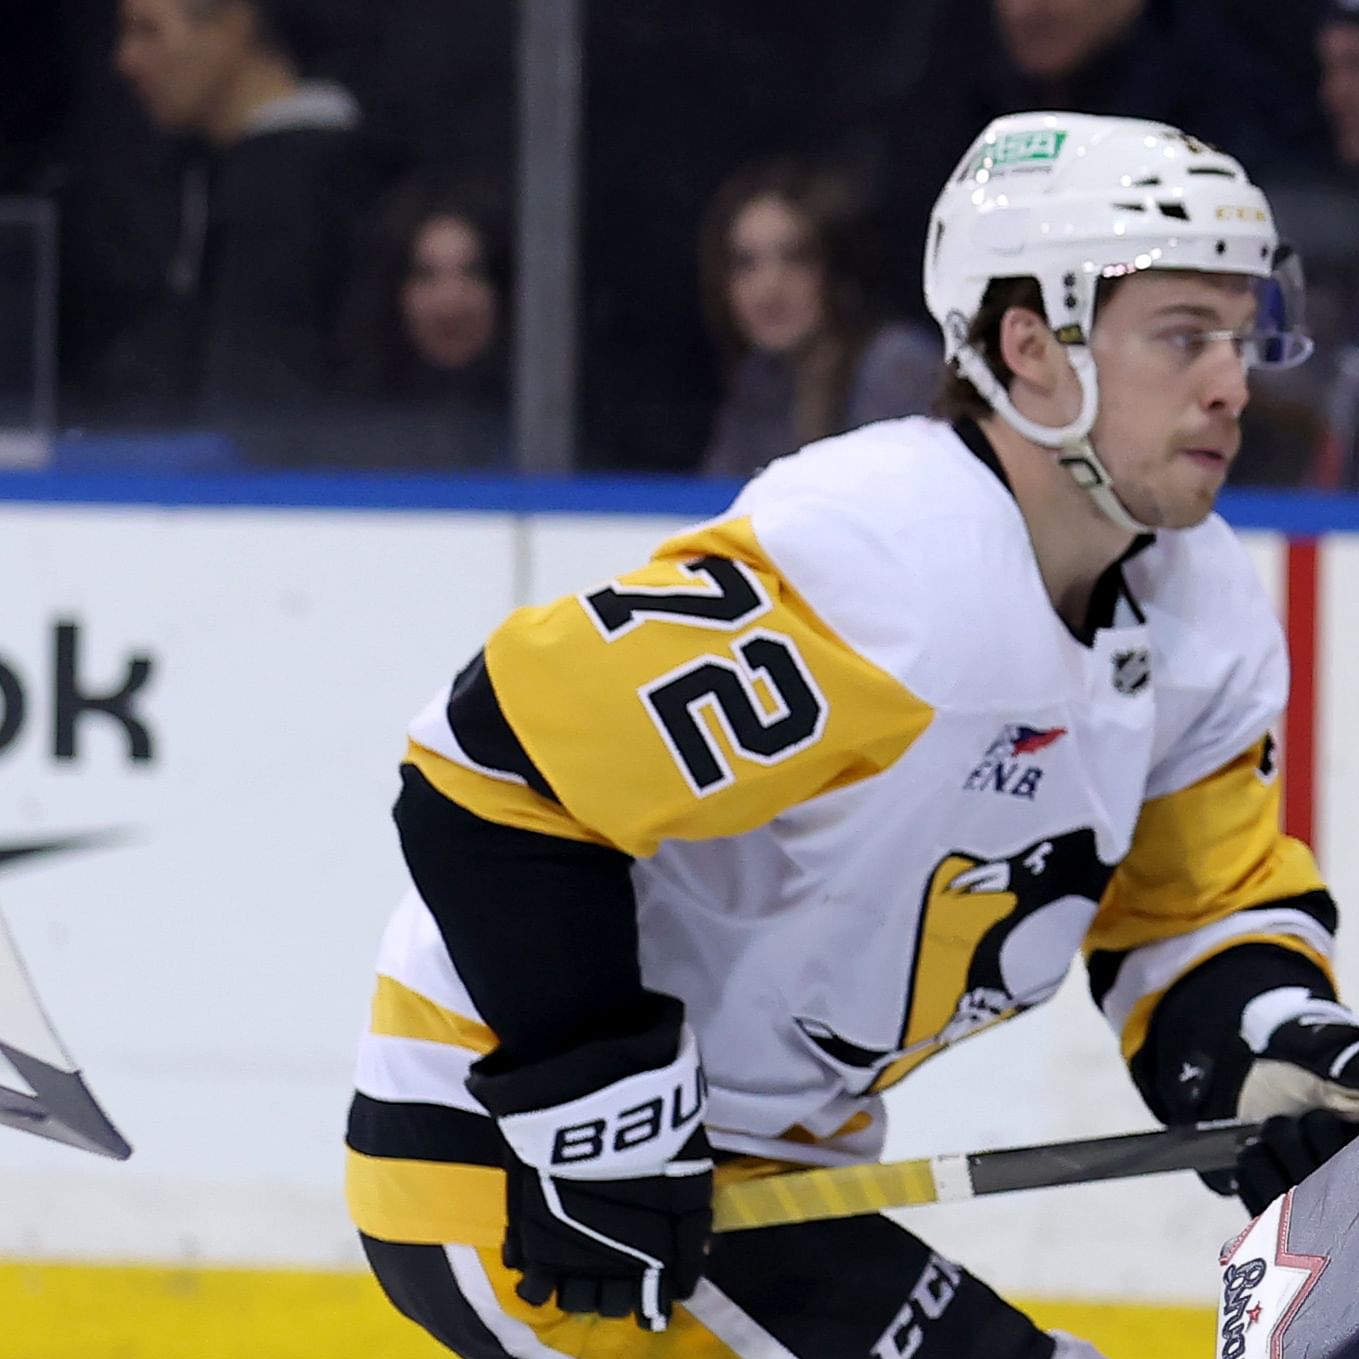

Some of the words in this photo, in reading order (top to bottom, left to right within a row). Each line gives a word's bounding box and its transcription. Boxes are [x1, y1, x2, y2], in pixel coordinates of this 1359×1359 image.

[0, 620, 154, 760] k
[578, 555, 829, 800] 72
[550, 1066, 708, 1166] BAU
